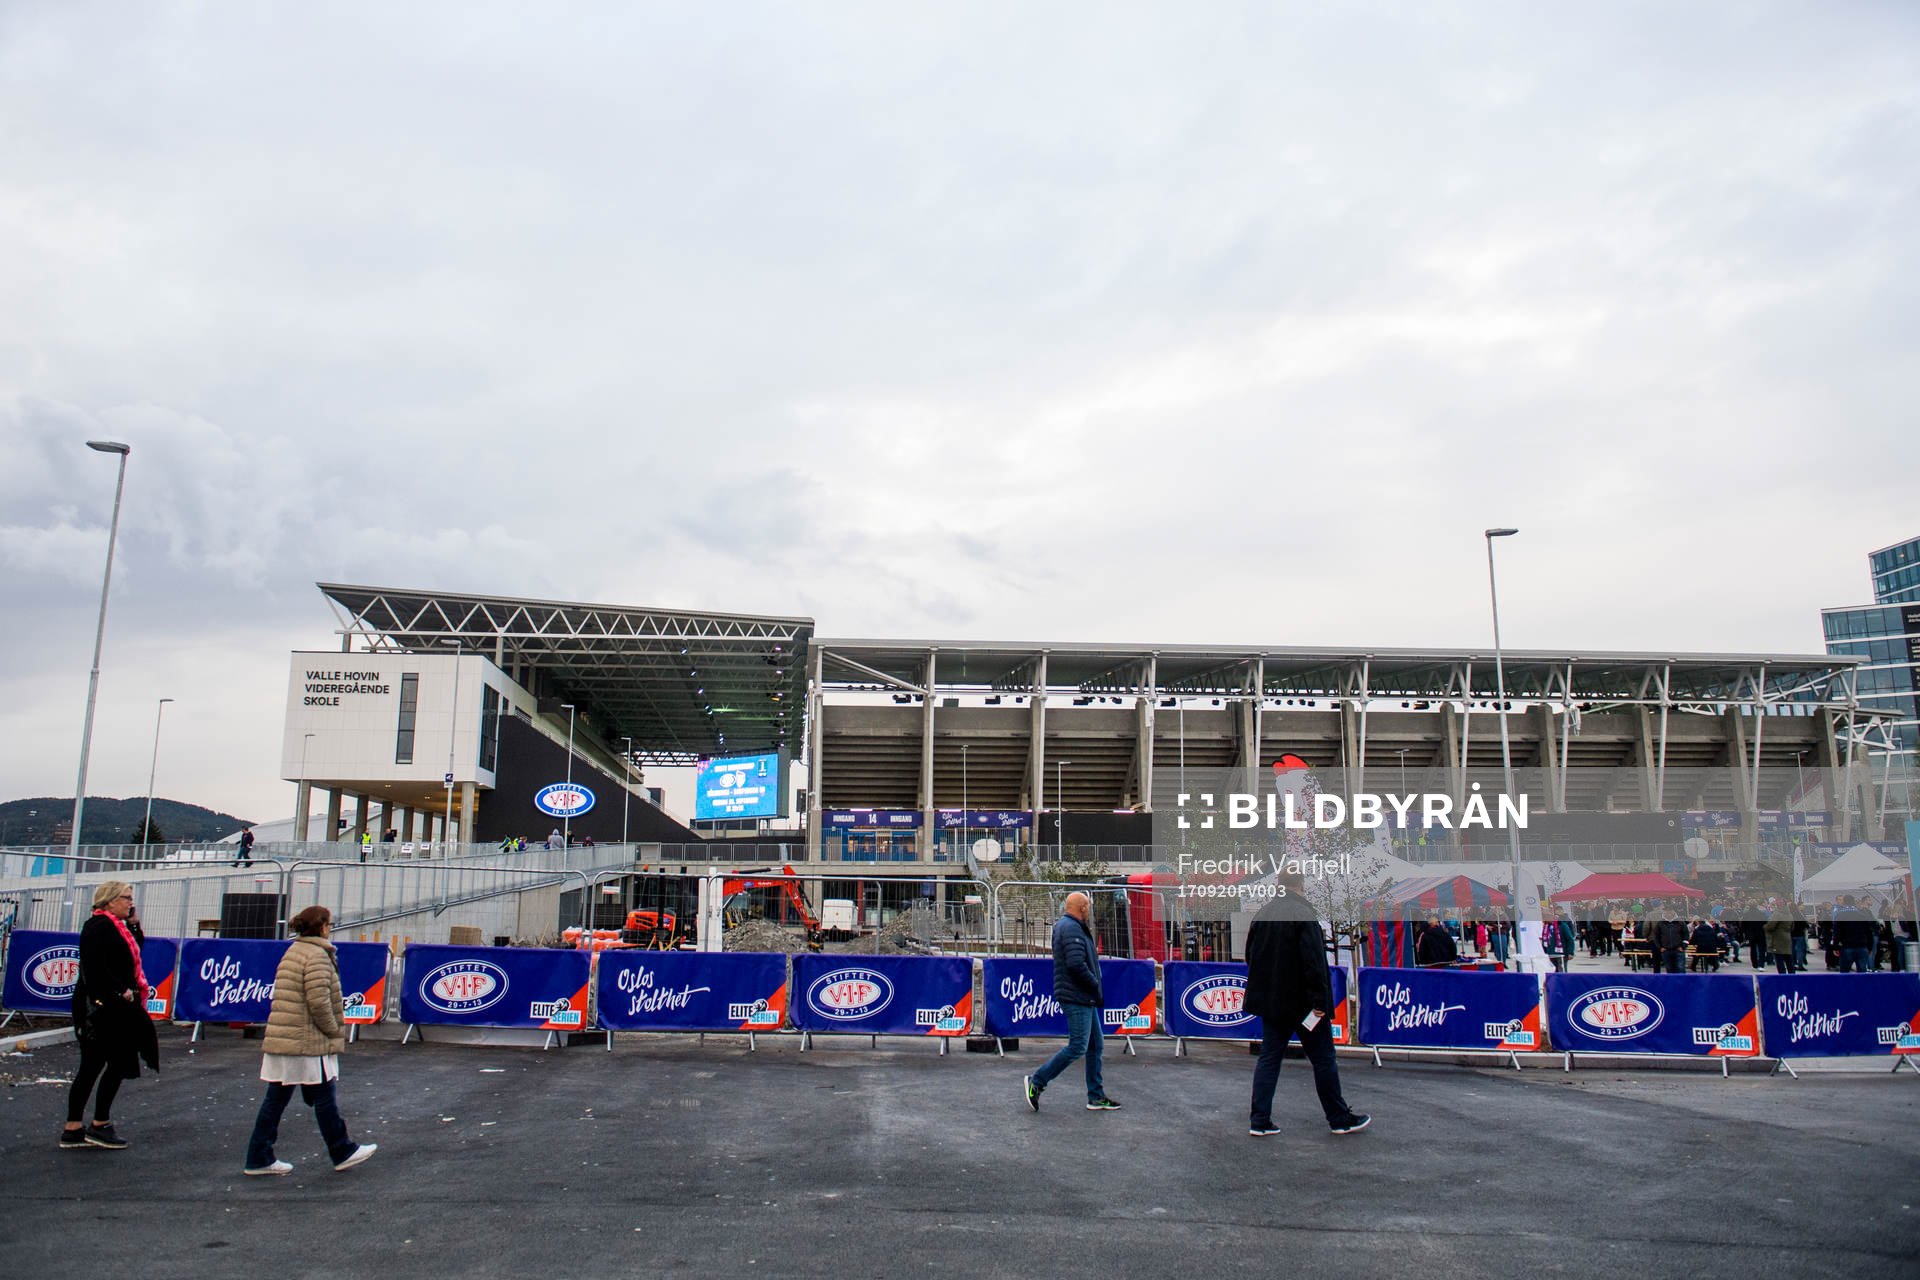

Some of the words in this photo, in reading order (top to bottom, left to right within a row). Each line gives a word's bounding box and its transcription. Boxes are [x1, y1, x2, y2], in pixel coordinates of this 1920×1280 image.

[306, 671, 341, 681] VALLE
[344, 671, 380, 681] HOVIN
[305, 682, 390, 694] VIDEREGÅENDE
[304, 696, 340, 706] SKOLE
[868, 813, 877, 824] 14
[200, 955, 241, 984] Oslos
[440, 964, 487, 977] STIFTET
[617, 965, 654, 994] Oslos
[825, 972, 872, 984] STIFTET
[1000, 974, 1033, 1001] Oslos
[1198, 979, 1245, 991] STIFTET
[628, 984, 711, 1016] stolthet
[1376, 982, 1411, 1009] Oslos
[1586, 990, 1638, 1004] STIFTET
[532, 1003, 555, 1017] ELITE
[731, 1005, 754, 1018] ELITE
[1777, 991, 1808, 1020] Oslos
[918, 1011, 941, 1024] ELITE
[1105, 1010, 1127, 1023] ELITE
[1388, 1002, 1466, 1032] stolthet
[1486, 1025, 1509, 1038] ELITE
[1790, 1009, 1860, 1043] stolthet
[1695, 1029, 1721, 1043] ELITE
[1879, 1029, 1902, 1042] ELITE
